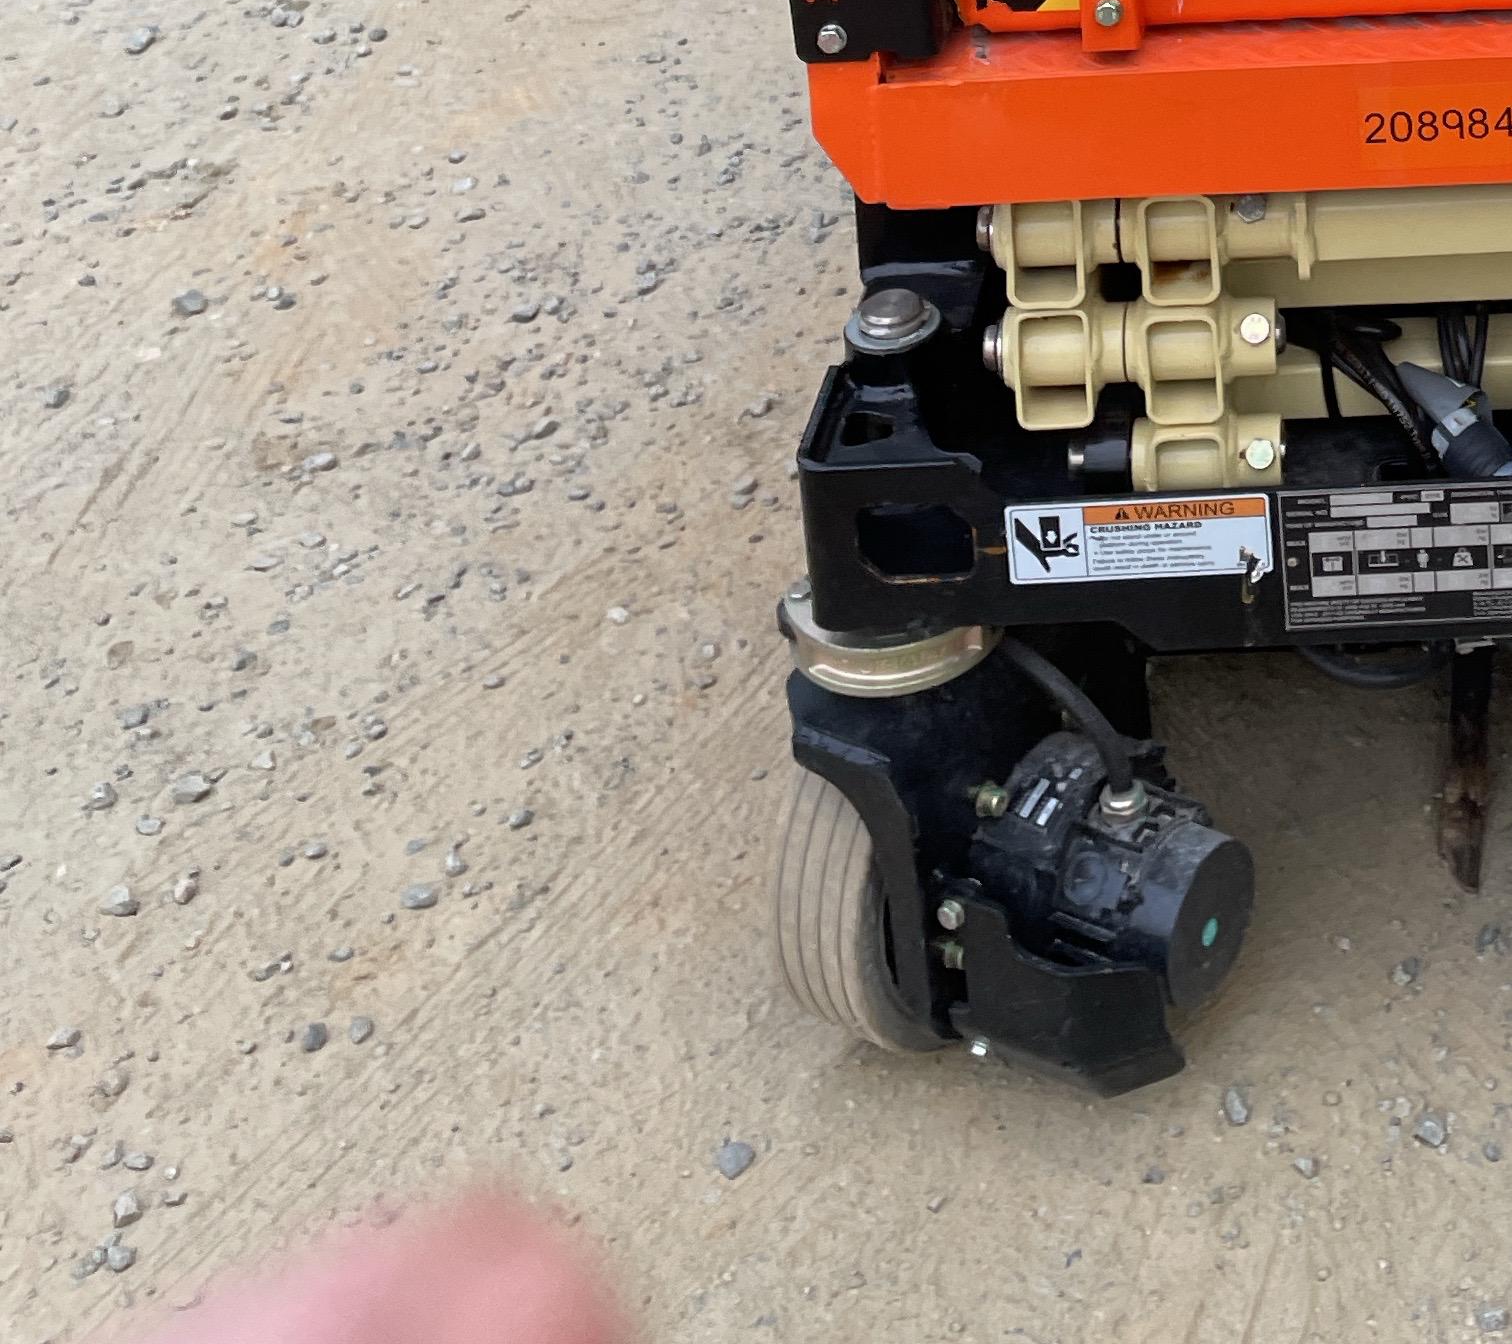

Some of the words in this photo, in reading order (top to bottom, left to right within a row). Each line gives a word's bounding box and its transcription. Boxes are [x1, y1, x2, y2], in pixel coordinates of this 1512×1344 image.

[1133, 501, 1235, 520] WARNING
[1089, 523, 1151, 533] CRUSHING
[1154, 521, 1202, 530] HAZARD
